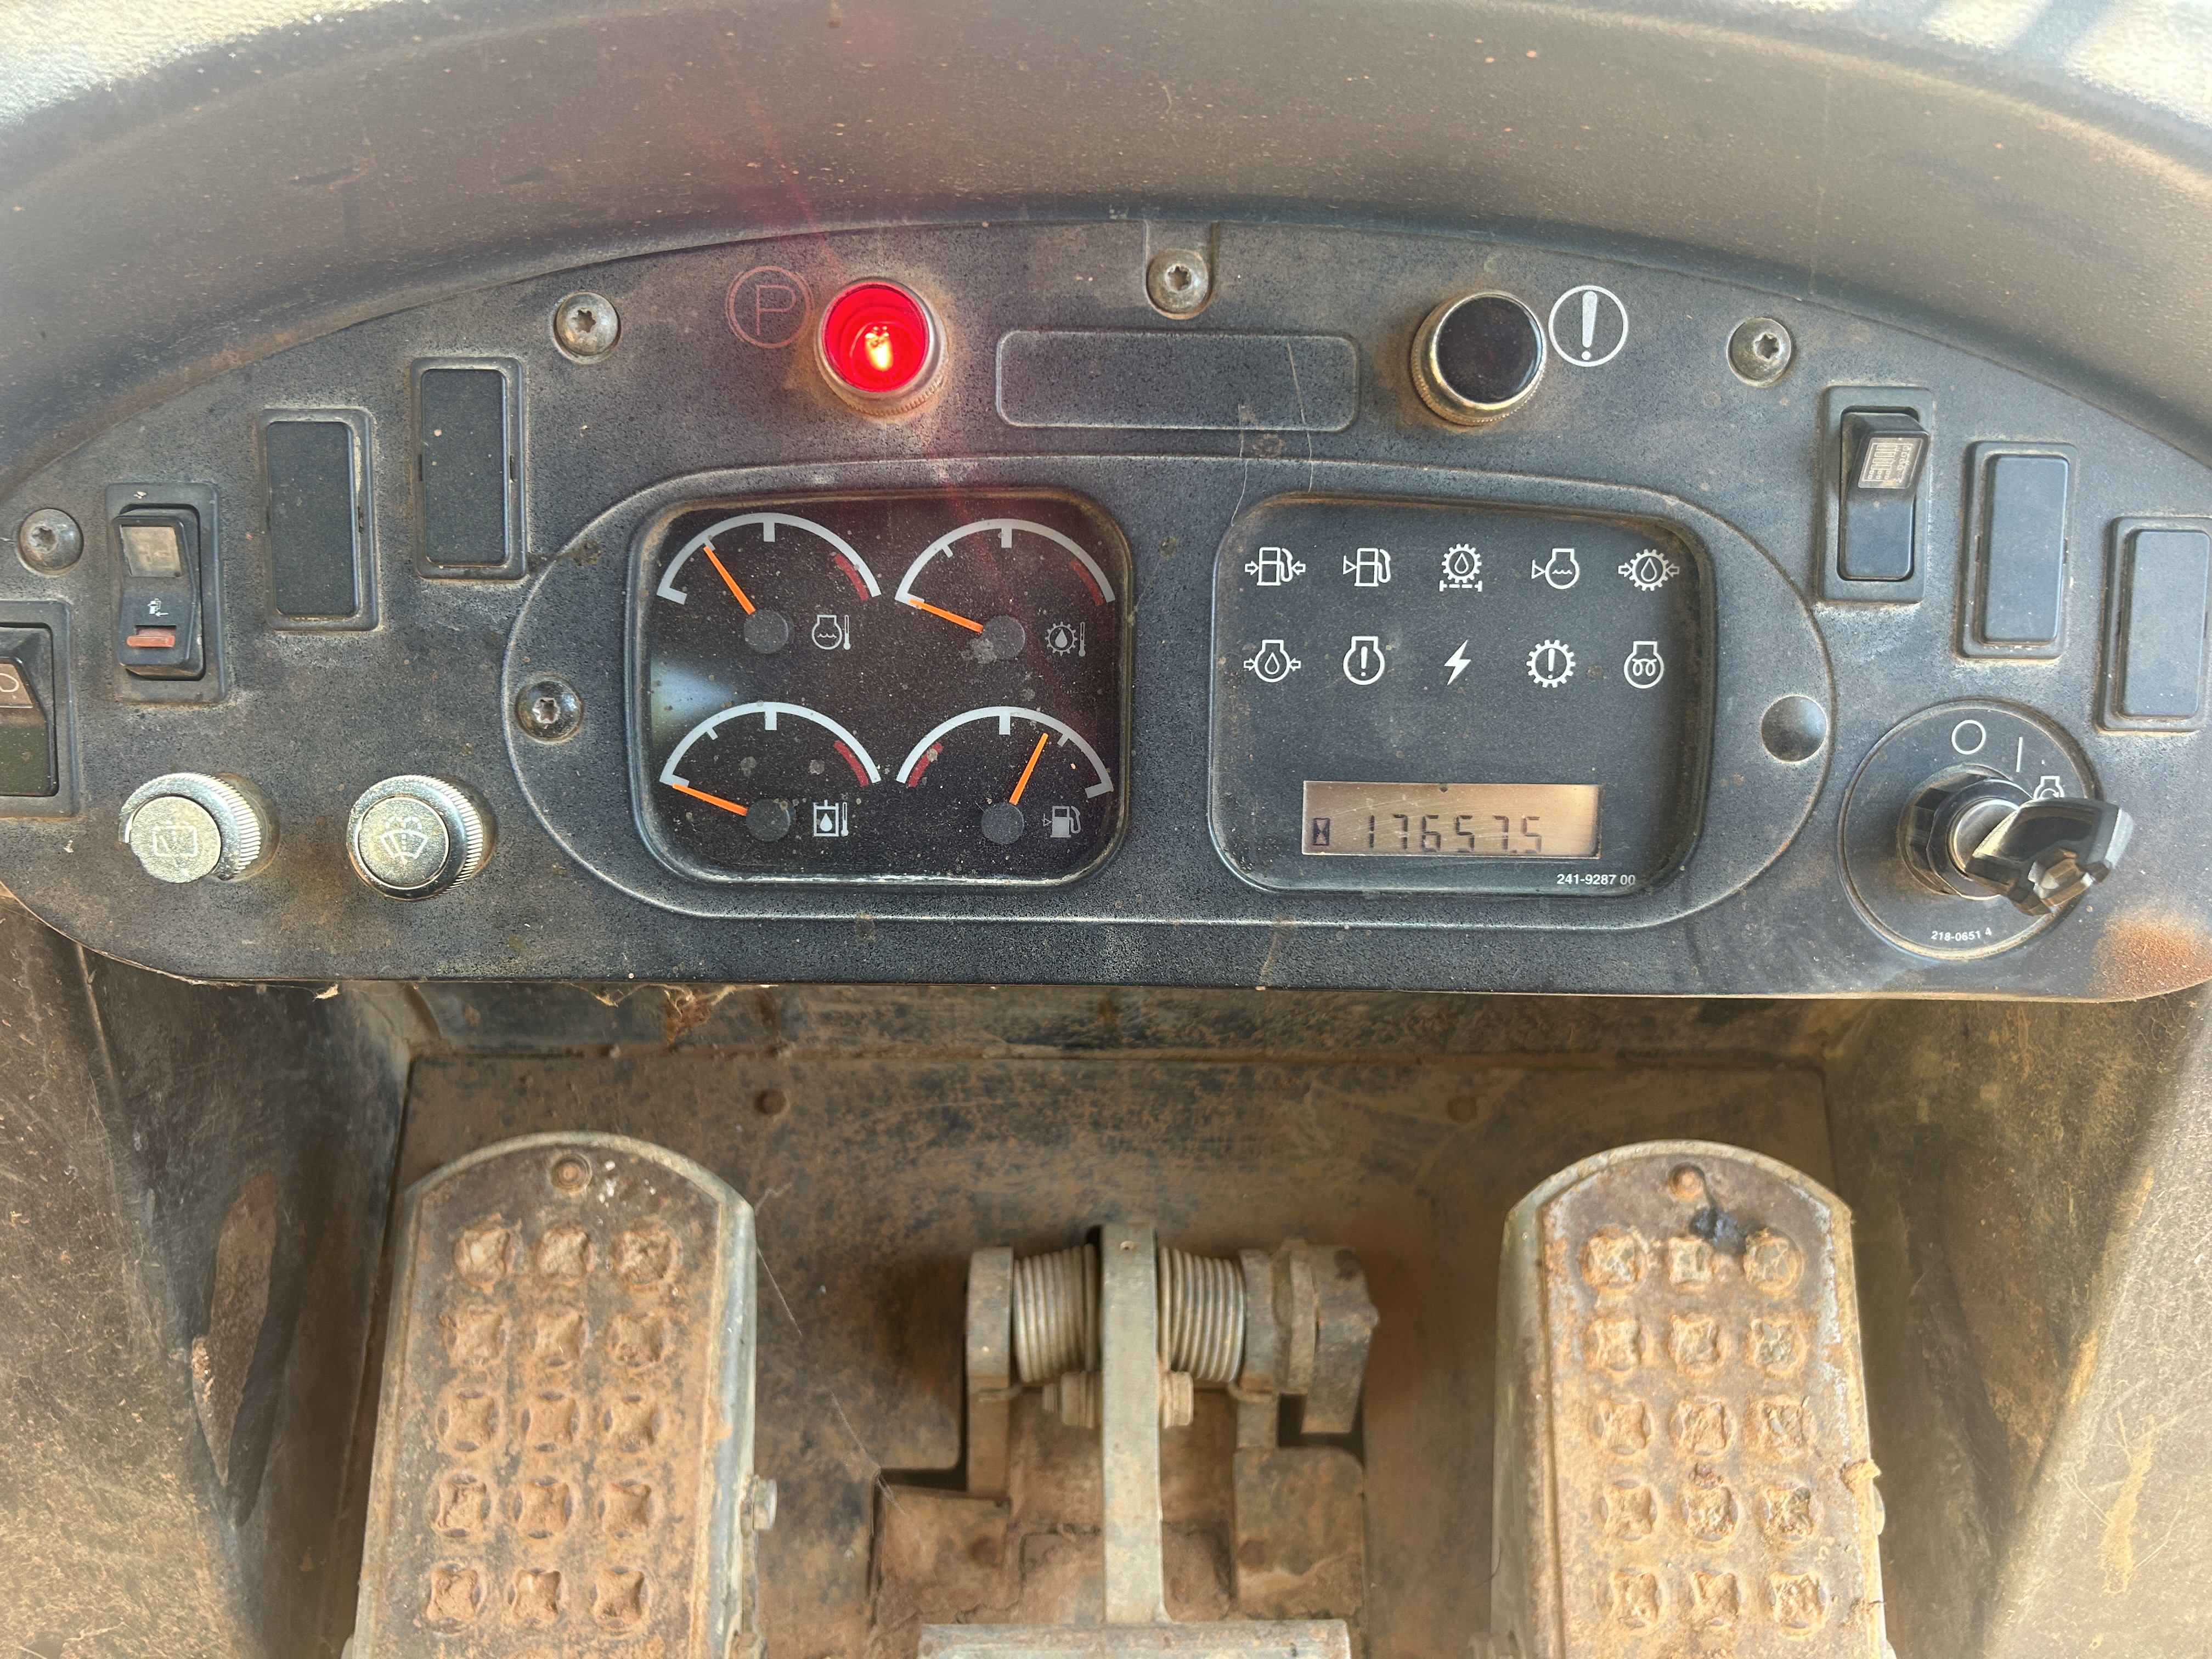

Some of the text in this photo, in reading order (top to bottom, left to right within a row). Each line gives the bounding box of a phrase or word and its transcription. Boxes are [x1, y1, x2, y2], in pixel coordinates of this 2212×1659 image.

[755, 285, 796, 336] P
[1556, 873, 1636, 885] 241-9287 00
[1931, 930, 1980, 941] 218-0651
